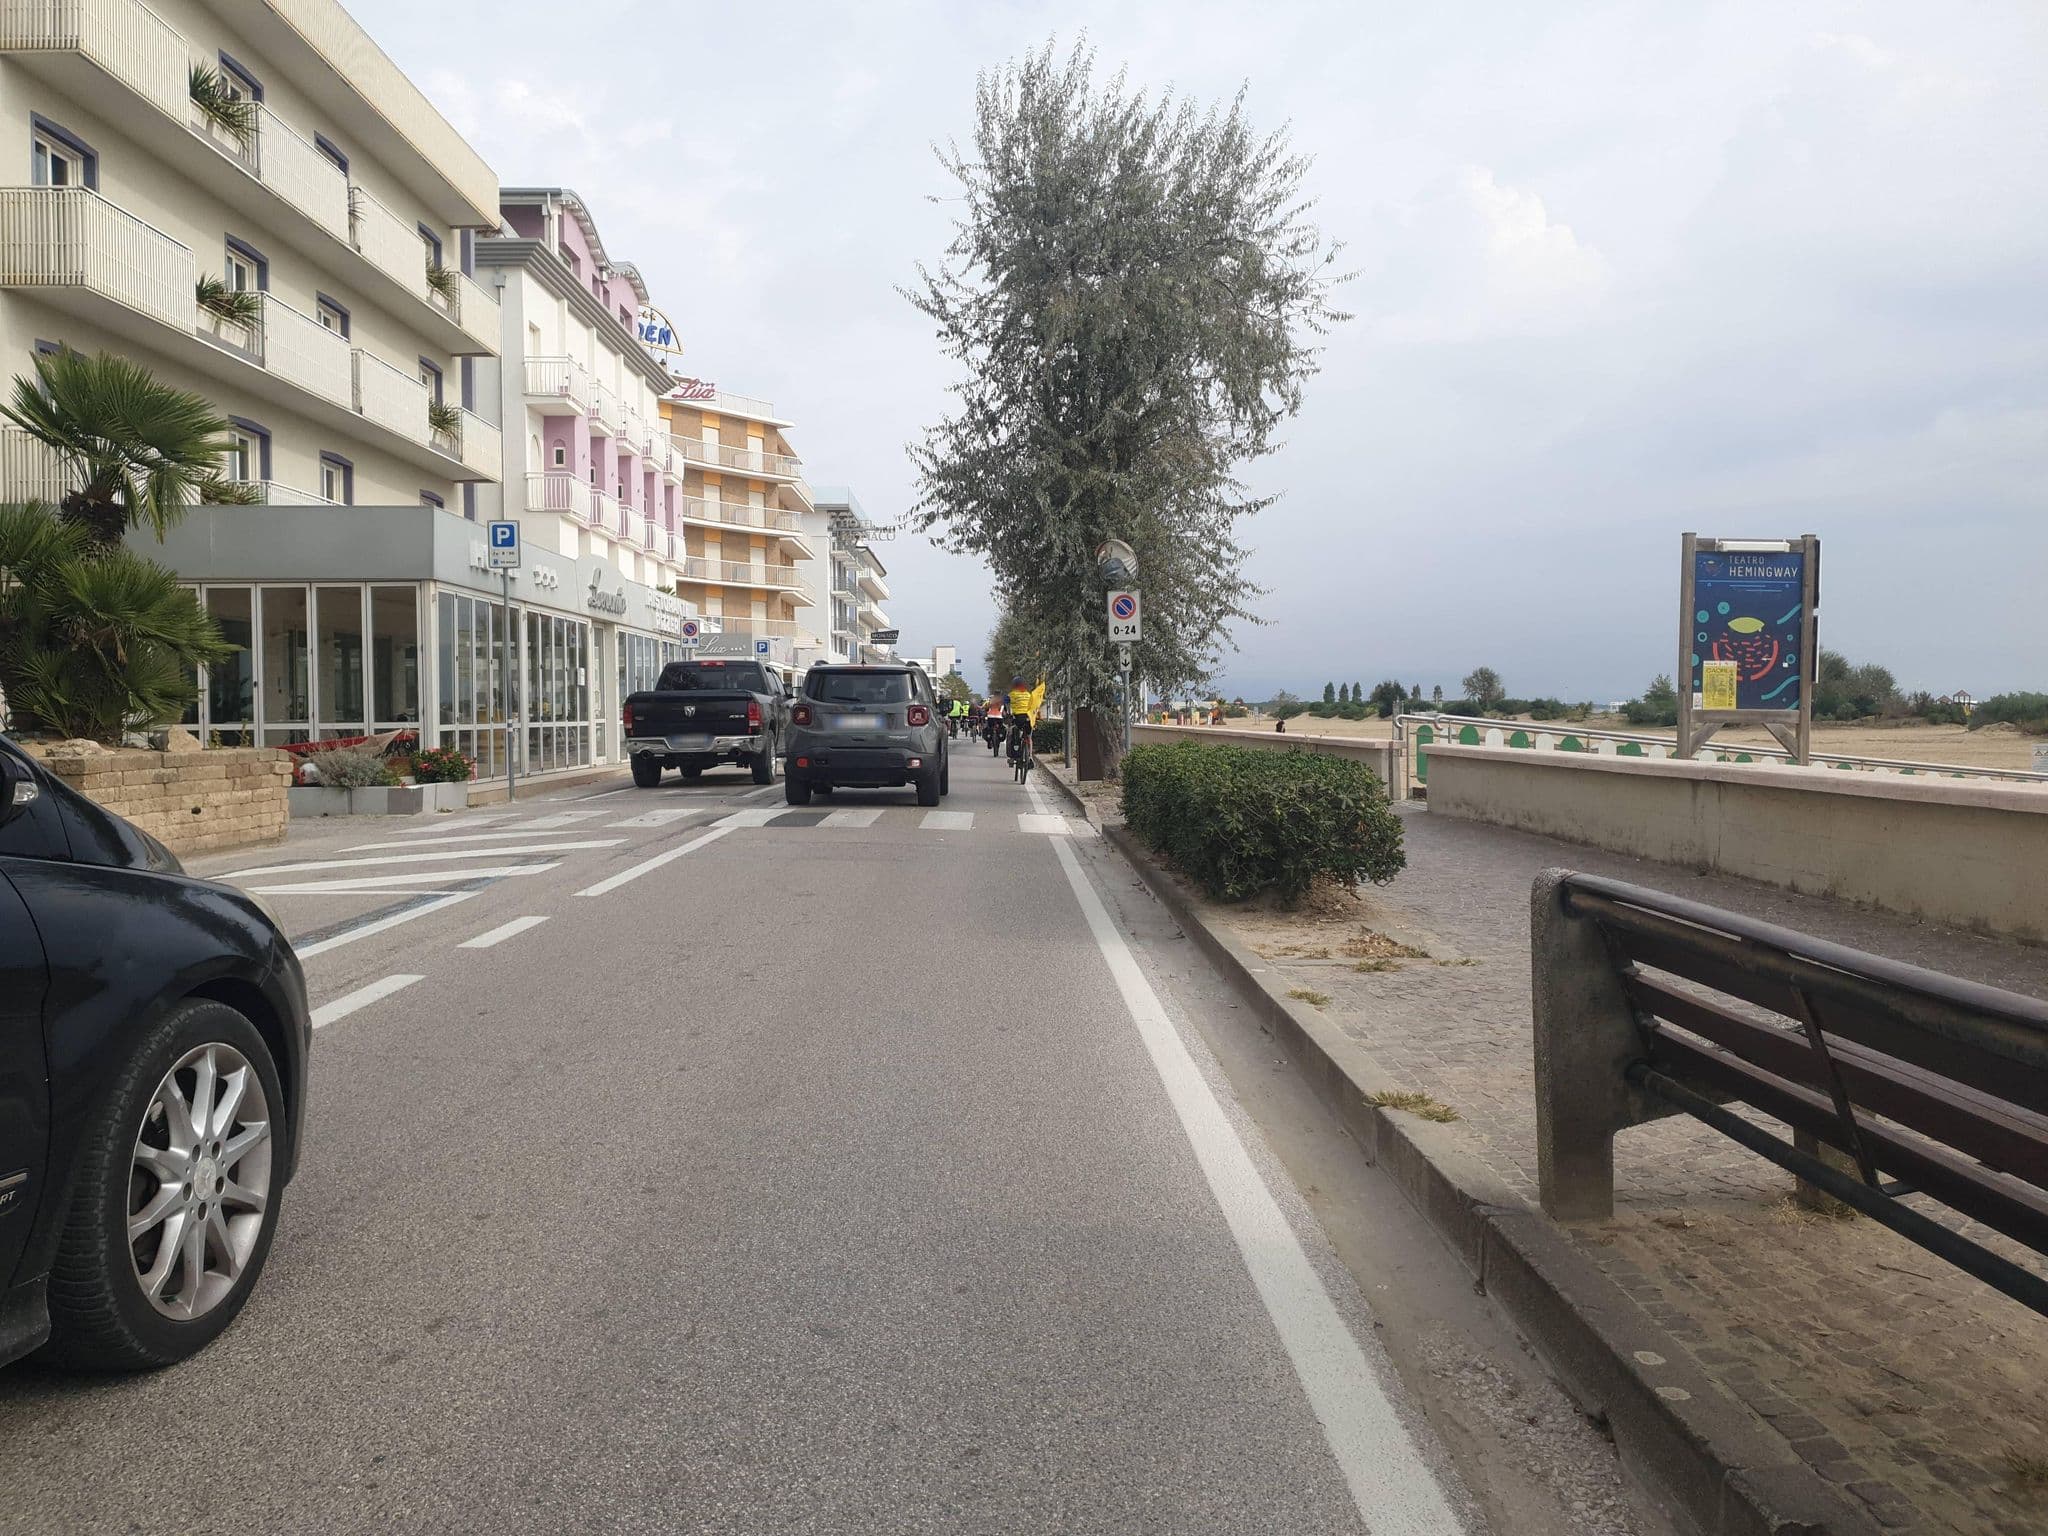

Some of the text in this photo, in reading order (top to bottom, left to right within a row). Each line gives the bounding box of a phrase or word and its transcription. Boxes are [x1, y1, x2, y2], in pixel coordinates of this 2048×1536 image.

[497, 527, 510, 545] P
[1729, 556, 1765, 564] TEATRO
[1729, 566, 1798, 577] HEMINGWAY
[1114, 625, 1136, 635] 0-24
